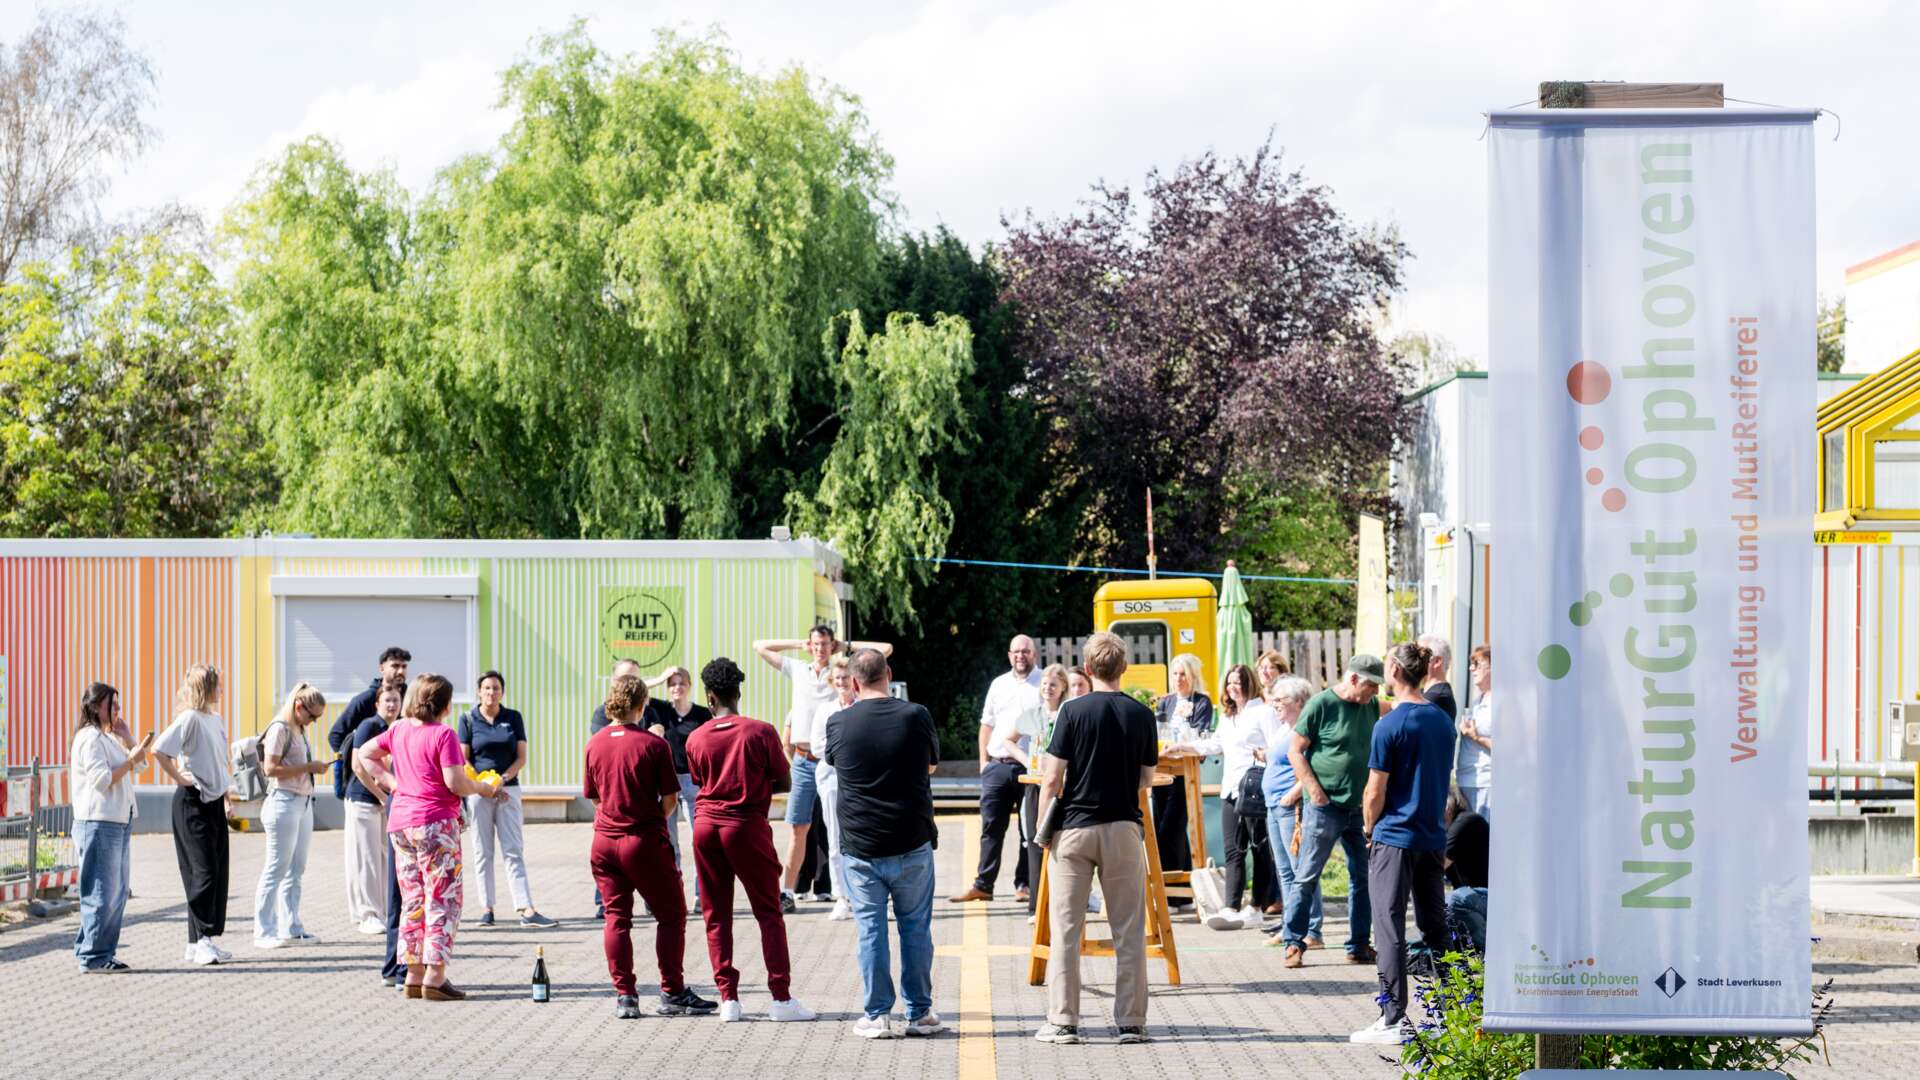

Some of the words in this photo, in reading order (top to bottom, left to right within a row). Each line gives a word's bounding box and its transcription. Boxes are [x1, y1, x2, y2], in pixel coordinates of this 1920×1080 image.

[1621, 143, 1717, 493] Ophoven
[1729, 317, 1759, 501] MutReiferei
[1731, 514, 1758, 571] und
[618, 613, 662, 629] MUT
[1124, 601, 1152, 613] SOS
[1730, 585, 1765, 762] Verwaltung
[1621, 528, 1698, 909] NaturGut
[1514, 972, 1576, 985] NaturGut
[1580, 972, 1639, 987] Ophoven
[1698, 978, 1724, 986] Stadt
[1726, 978, 1782, 986] Leverkusen
